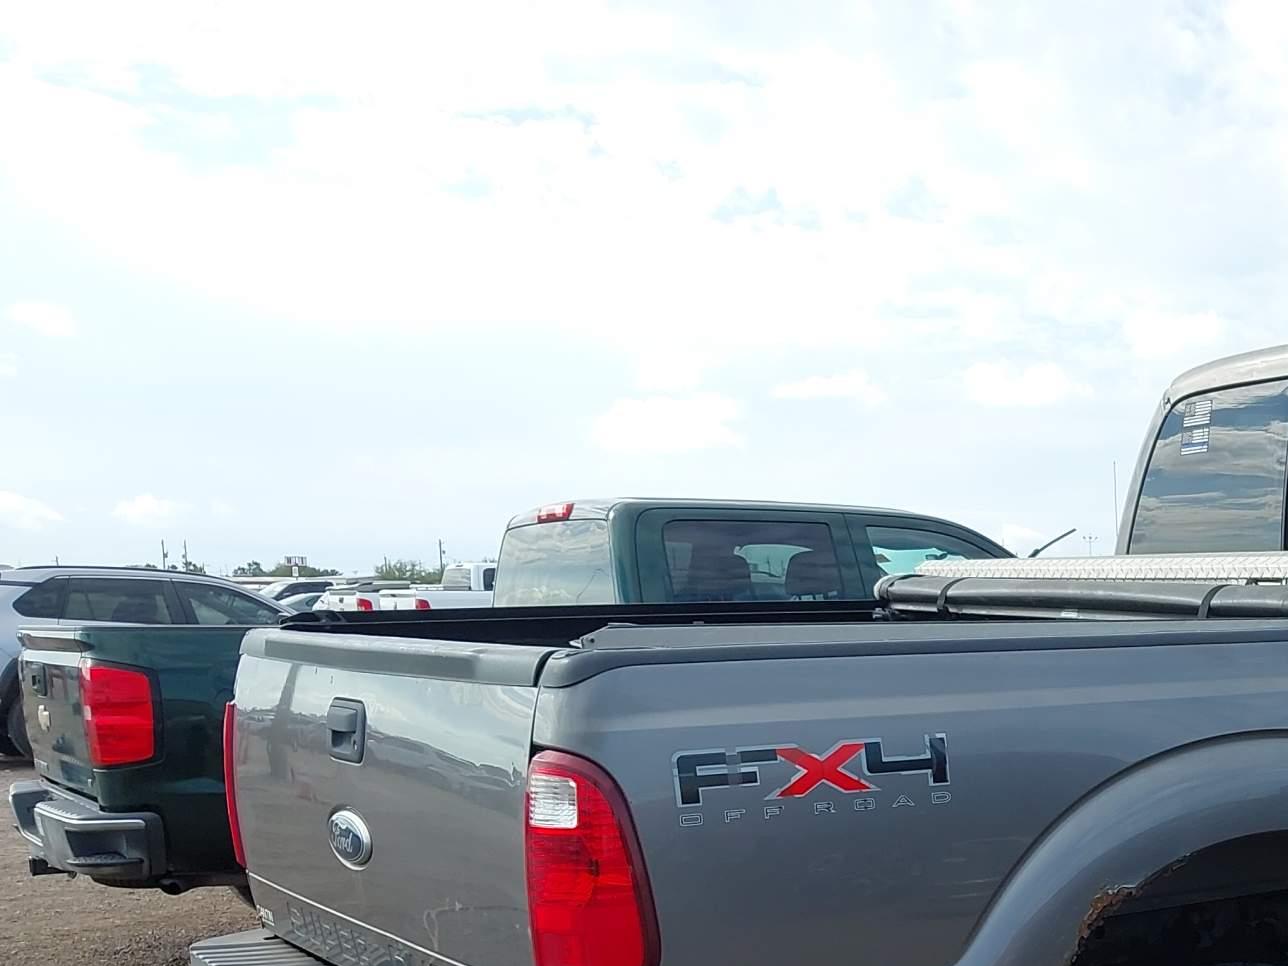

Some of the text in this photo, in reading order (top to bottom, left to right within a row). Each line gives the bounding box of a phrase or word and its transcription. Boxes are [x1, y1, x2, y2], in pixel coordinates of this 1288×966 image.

[671, 732, 951, 808] FX4
[679, 791, 952, 827] OFF ROAD
